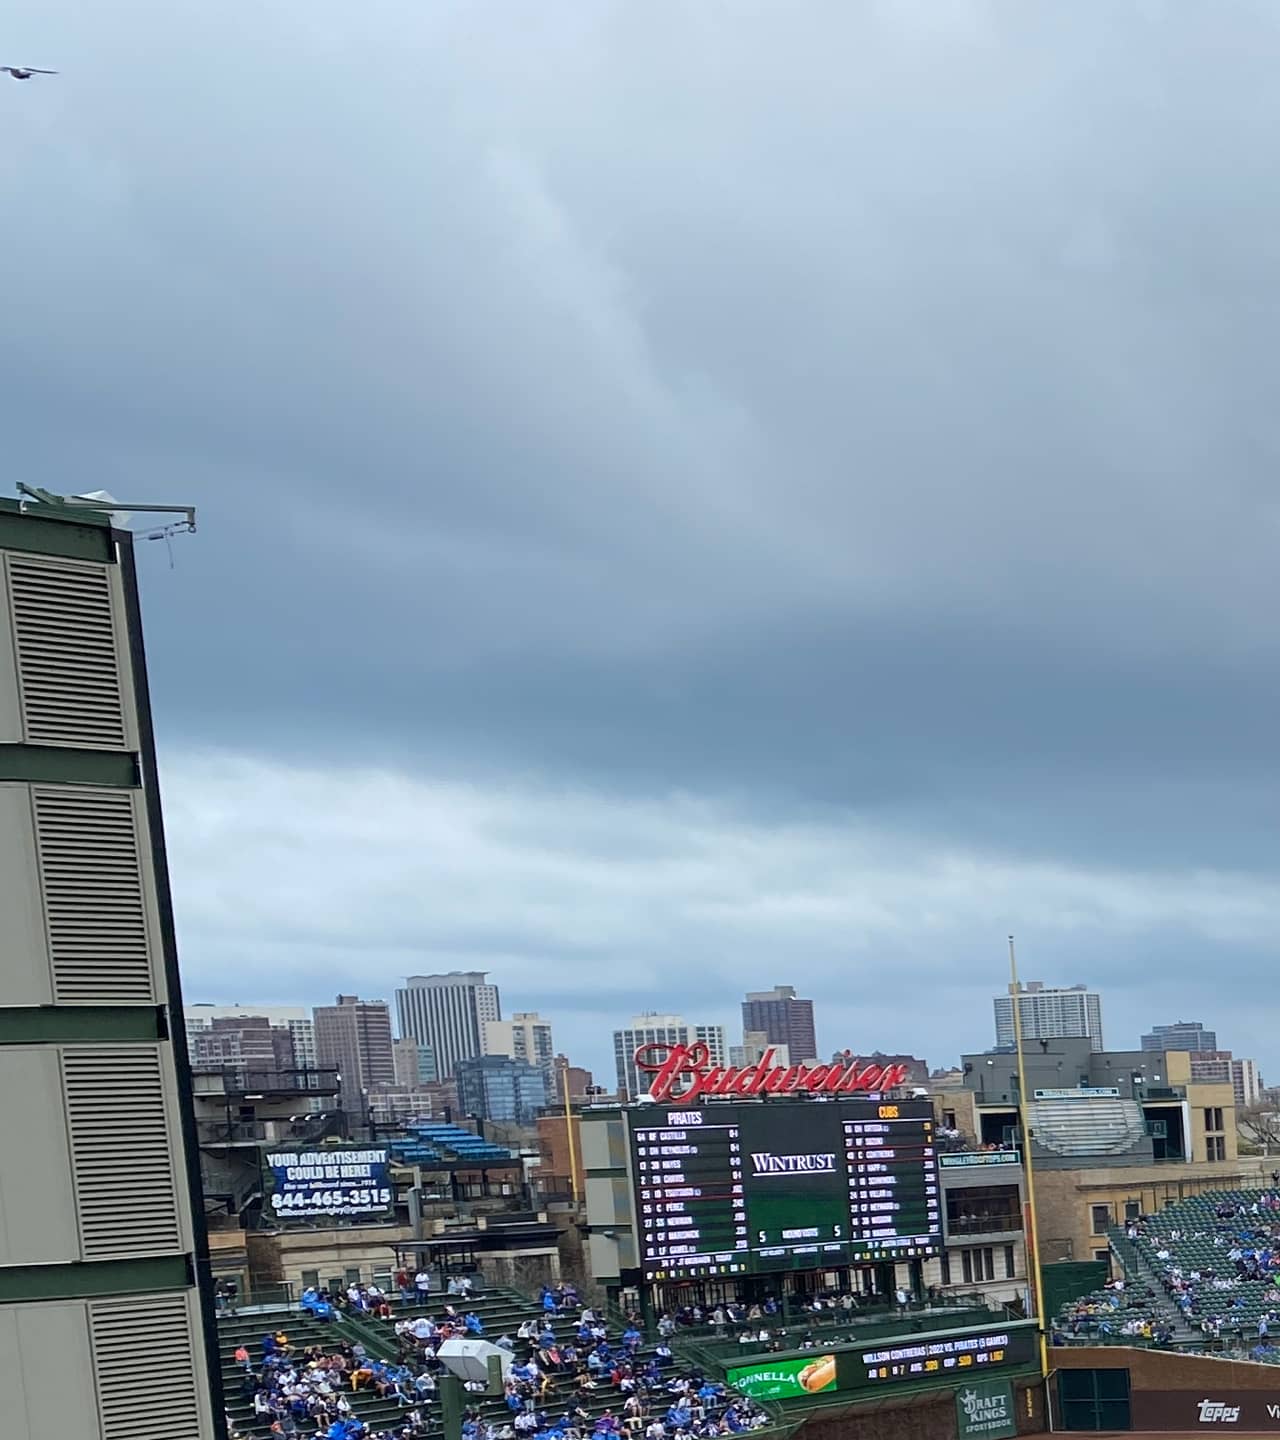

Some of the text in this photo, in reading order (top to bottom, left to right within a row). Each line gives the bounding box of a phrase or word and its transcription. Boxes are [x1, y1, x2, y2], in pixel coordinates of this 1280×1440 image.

[634, 1041, 907, 1103] Budweiser
[668, 1112, 702, 1125] PIRATES
[879, 1106, 898, 1118] CUBS
[267, 1150, 386, 1167] YOUR ADVERTISEMENT
[751, 1153, 835, 1172] WINTRUST
[286, 1164, 371, 1180] COULD BE HERE!
[271, 1189, 391, 1208] 844-465-3515
[759, 1231, 766, 1242] 5
[834, 1225, 841, 1236] 5
[863, 1351, 890, 1364] WILLSON
[891, 1347, 925, 1360] CONTRERAS
[929, 1345, 944, 1354] 2022
[954, 1339, 978, 1351] PIRATES
[964, 1394, 1007, 1414] DRAFT
[970, 1407, 1007, 1422] KINGS
